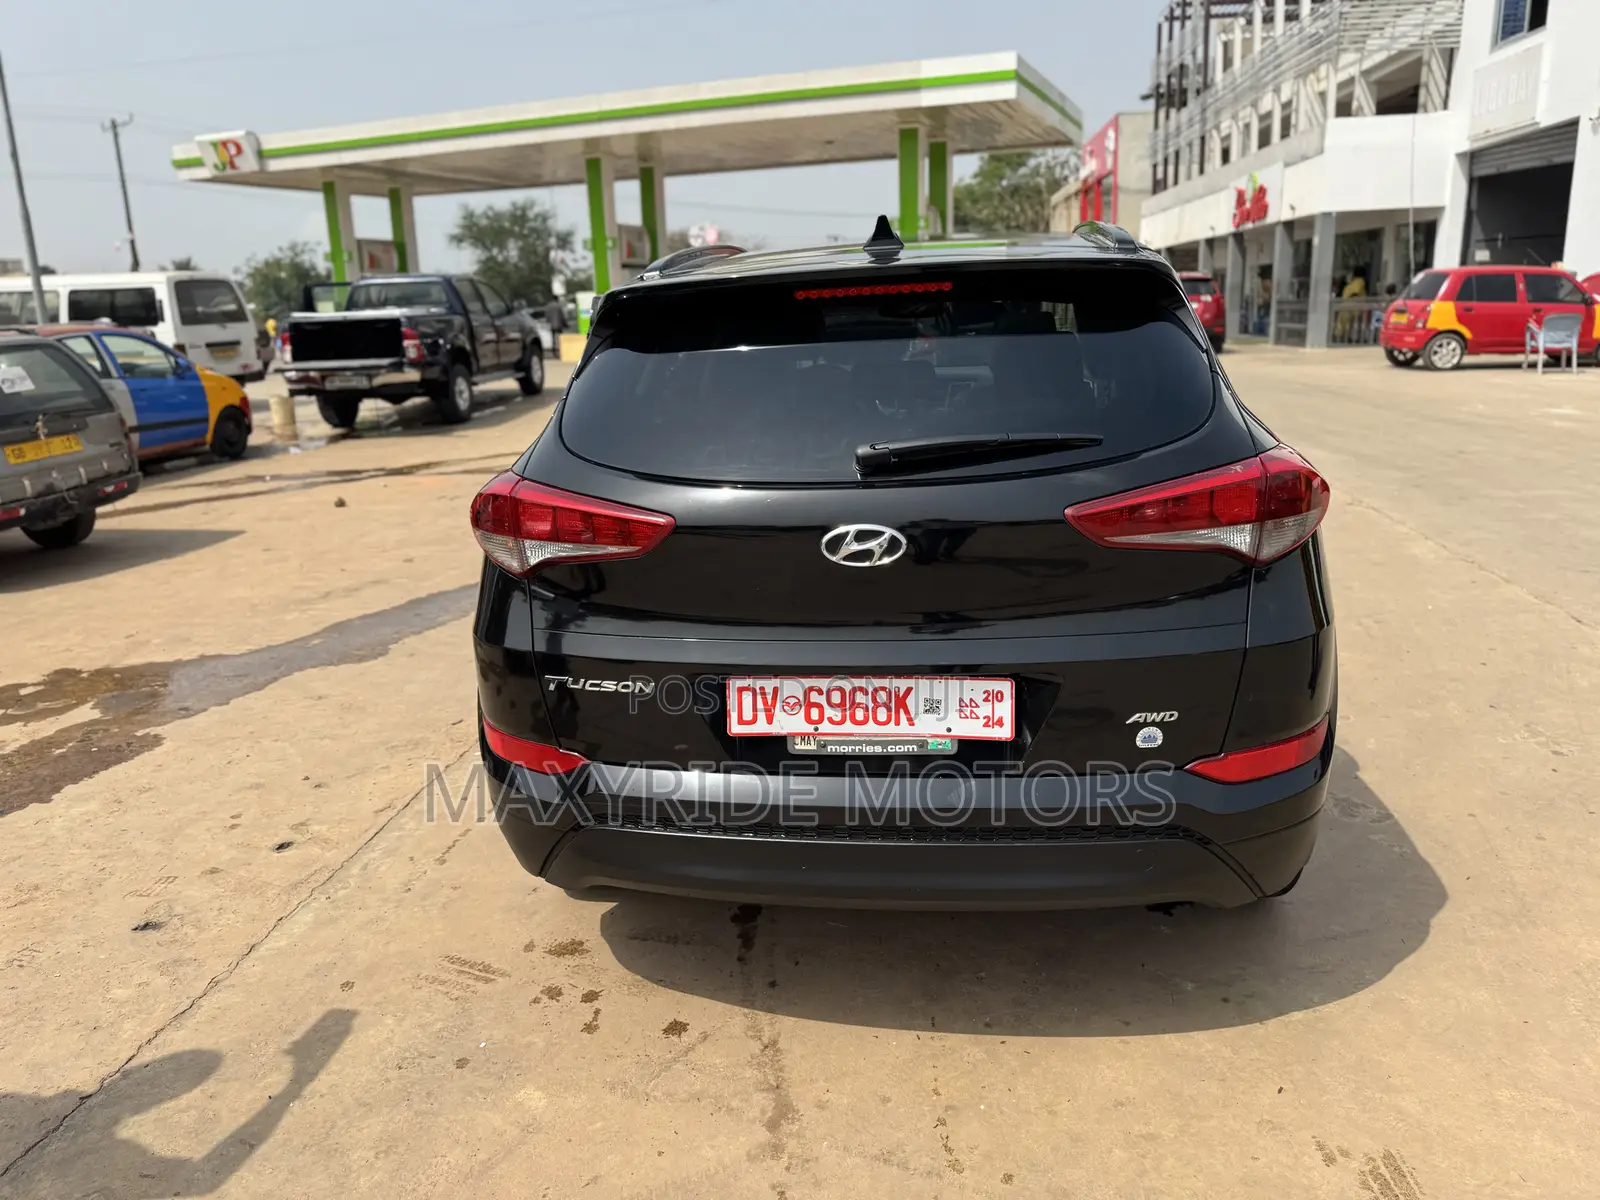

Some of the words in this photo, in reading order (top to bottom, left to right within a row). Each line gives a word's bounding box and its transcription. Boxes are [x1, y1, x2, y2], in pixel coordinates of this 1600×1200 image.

[736, 685, 779, 725] DV
[803, 685, 915, 726] 6968K
[1125, 710, 1179, 724] AWD
[827, 743, 917, 753] morries.com
